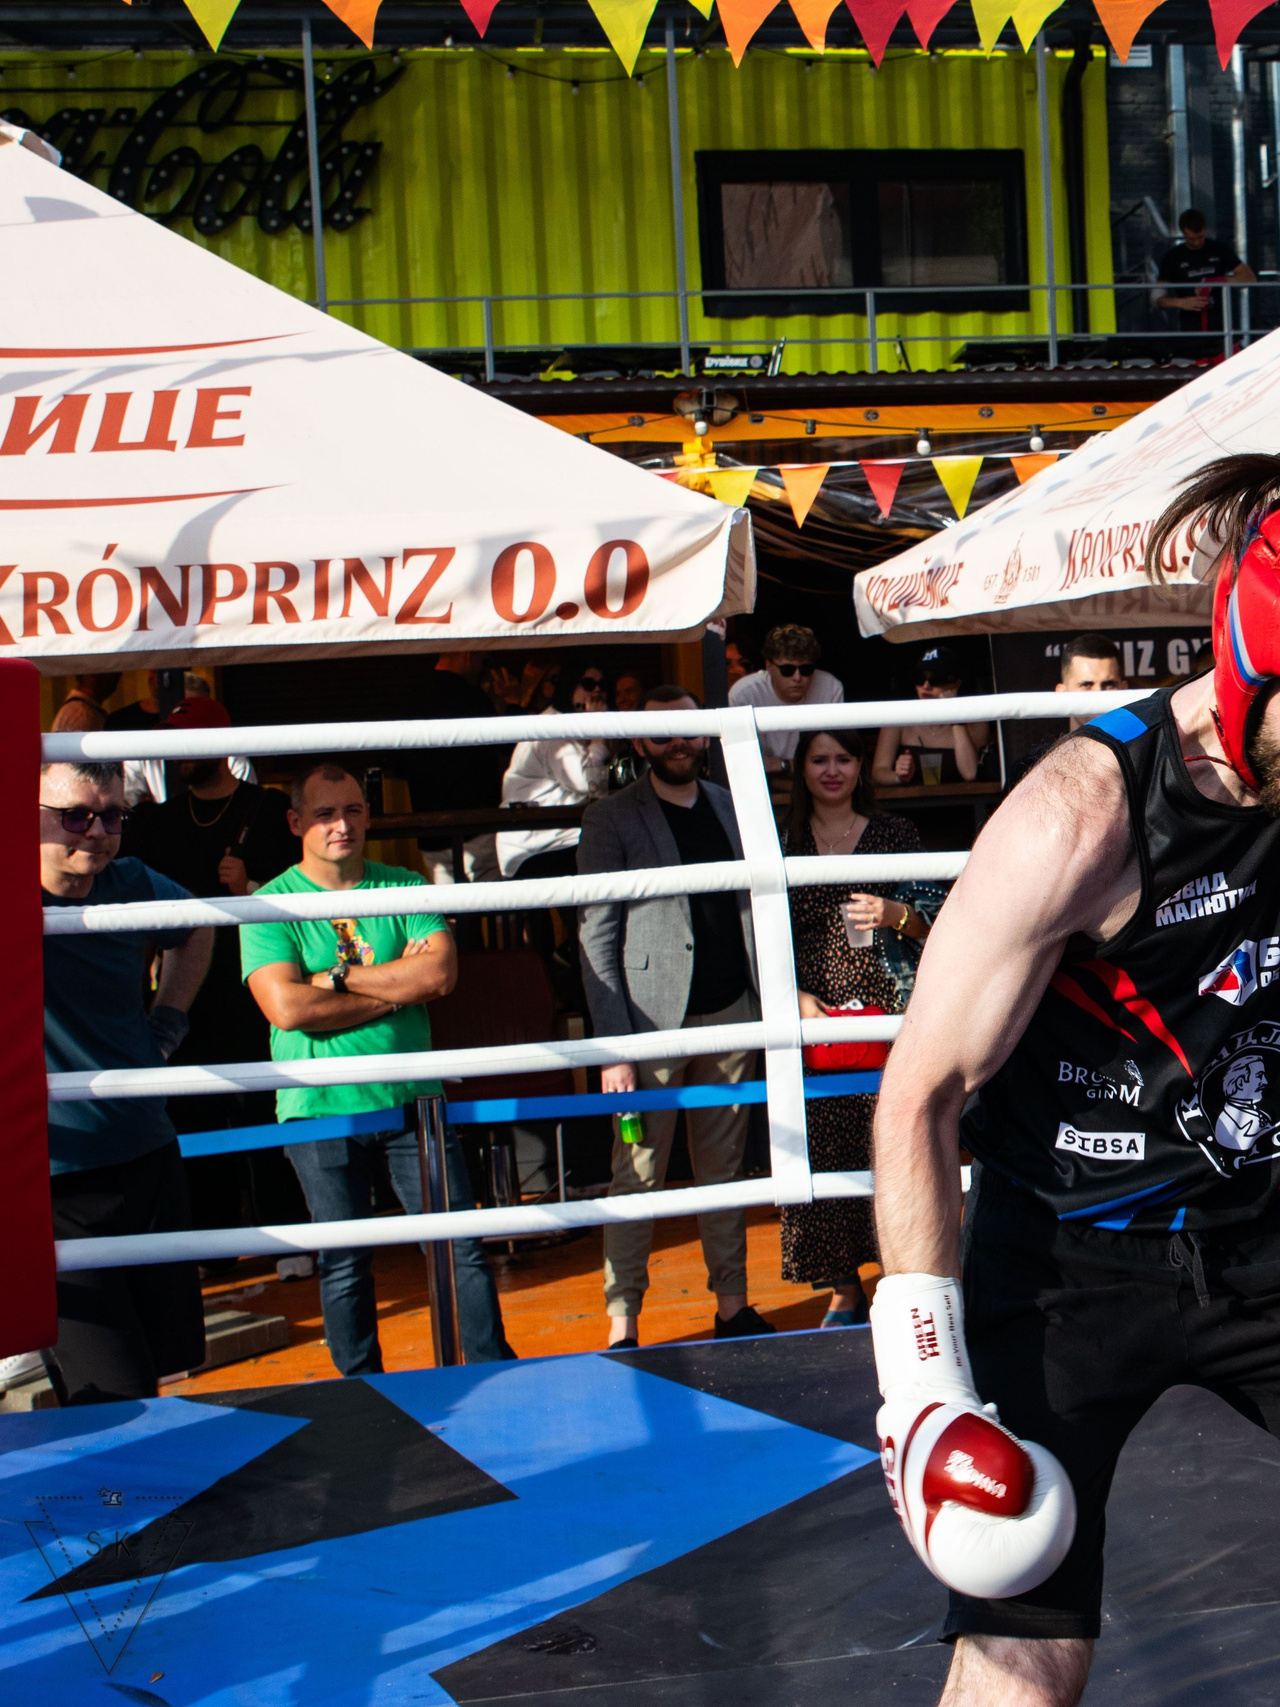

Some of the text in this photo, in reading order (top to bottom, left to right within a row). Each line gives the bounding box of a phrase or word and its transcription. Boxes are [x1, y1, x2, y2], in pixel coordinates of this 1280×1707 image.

[491, 539, 650, 623] 0.0
[1086, 1088, 1114, 1100] GIN
[1063, 1130, 1139, 1155] SIBSA
[923, 1311, 940, 1358] HILL
